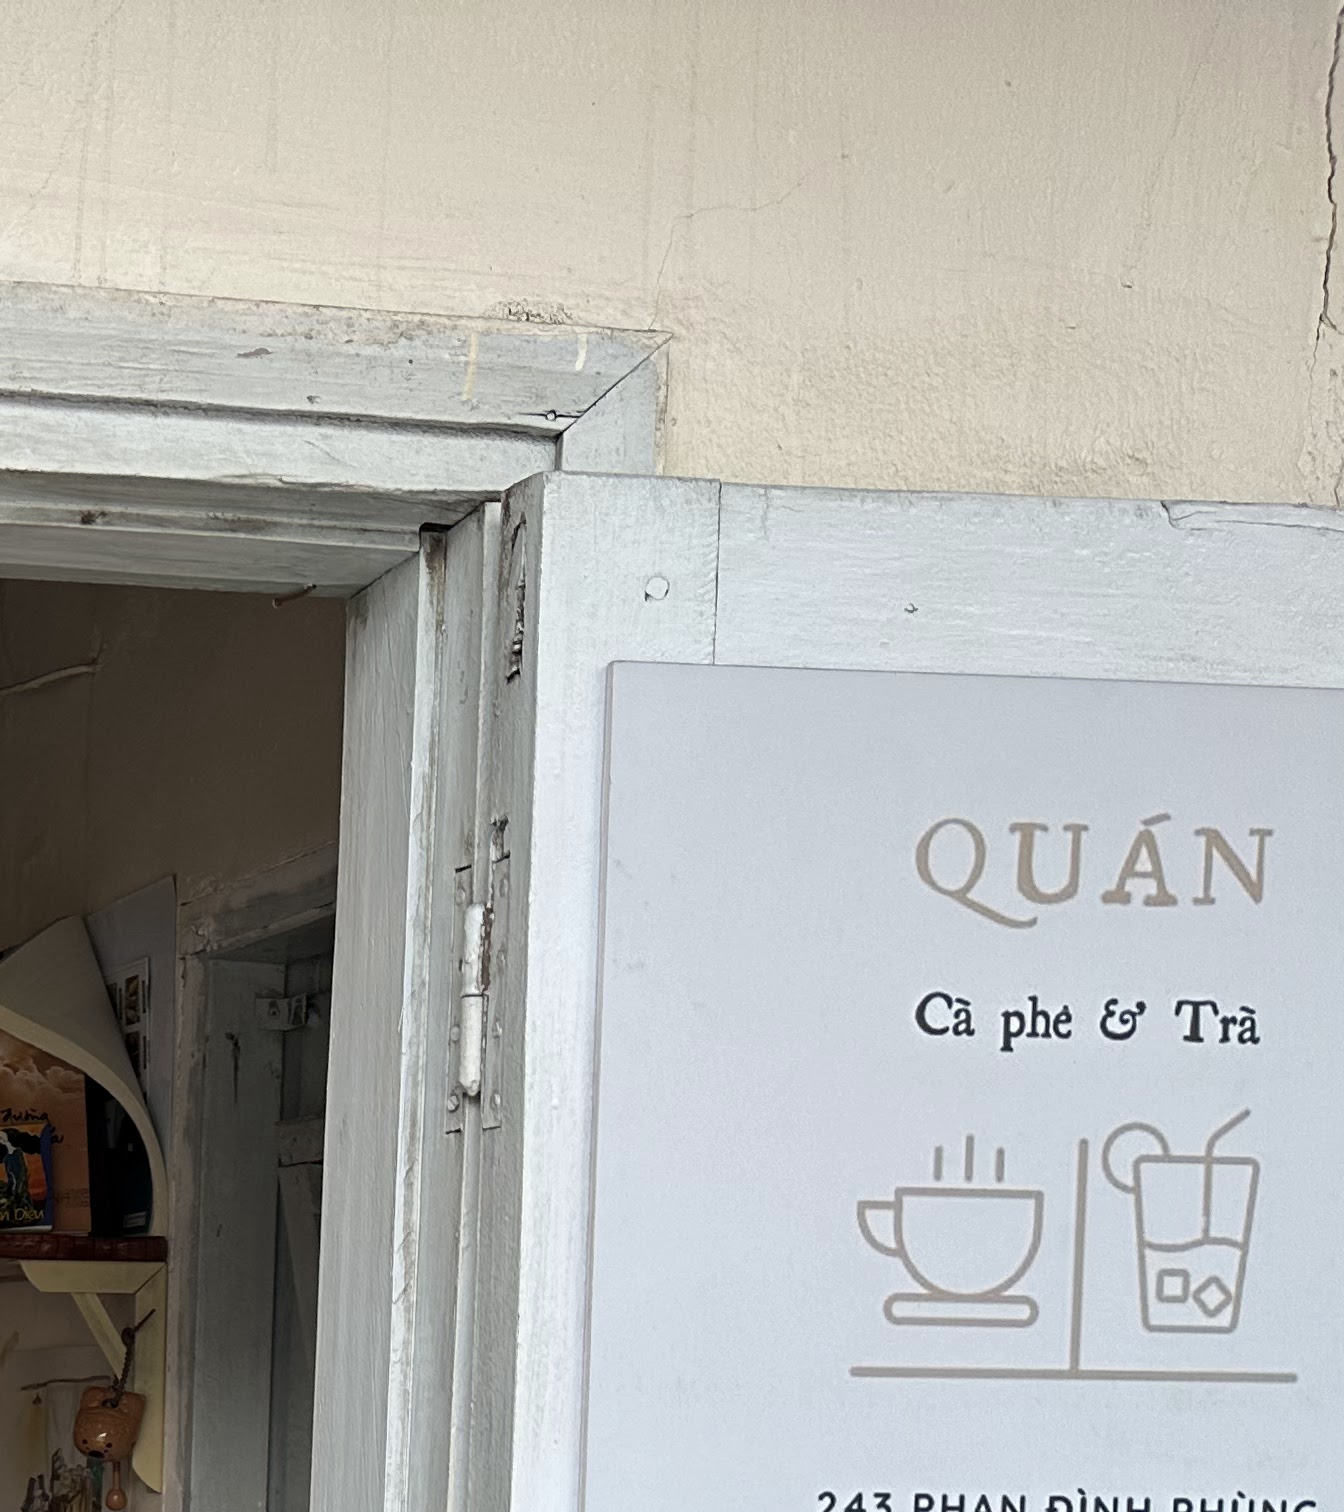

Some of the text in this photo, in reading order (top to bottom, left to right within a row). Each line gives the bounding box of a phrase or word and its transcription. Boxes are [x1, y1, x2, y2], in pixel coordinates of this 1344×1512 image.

[916, 813, 1273, 930] QUÁN
[1099, 997, 1147, 1041] &
[1174, 999, 1261, 1045] Trà
